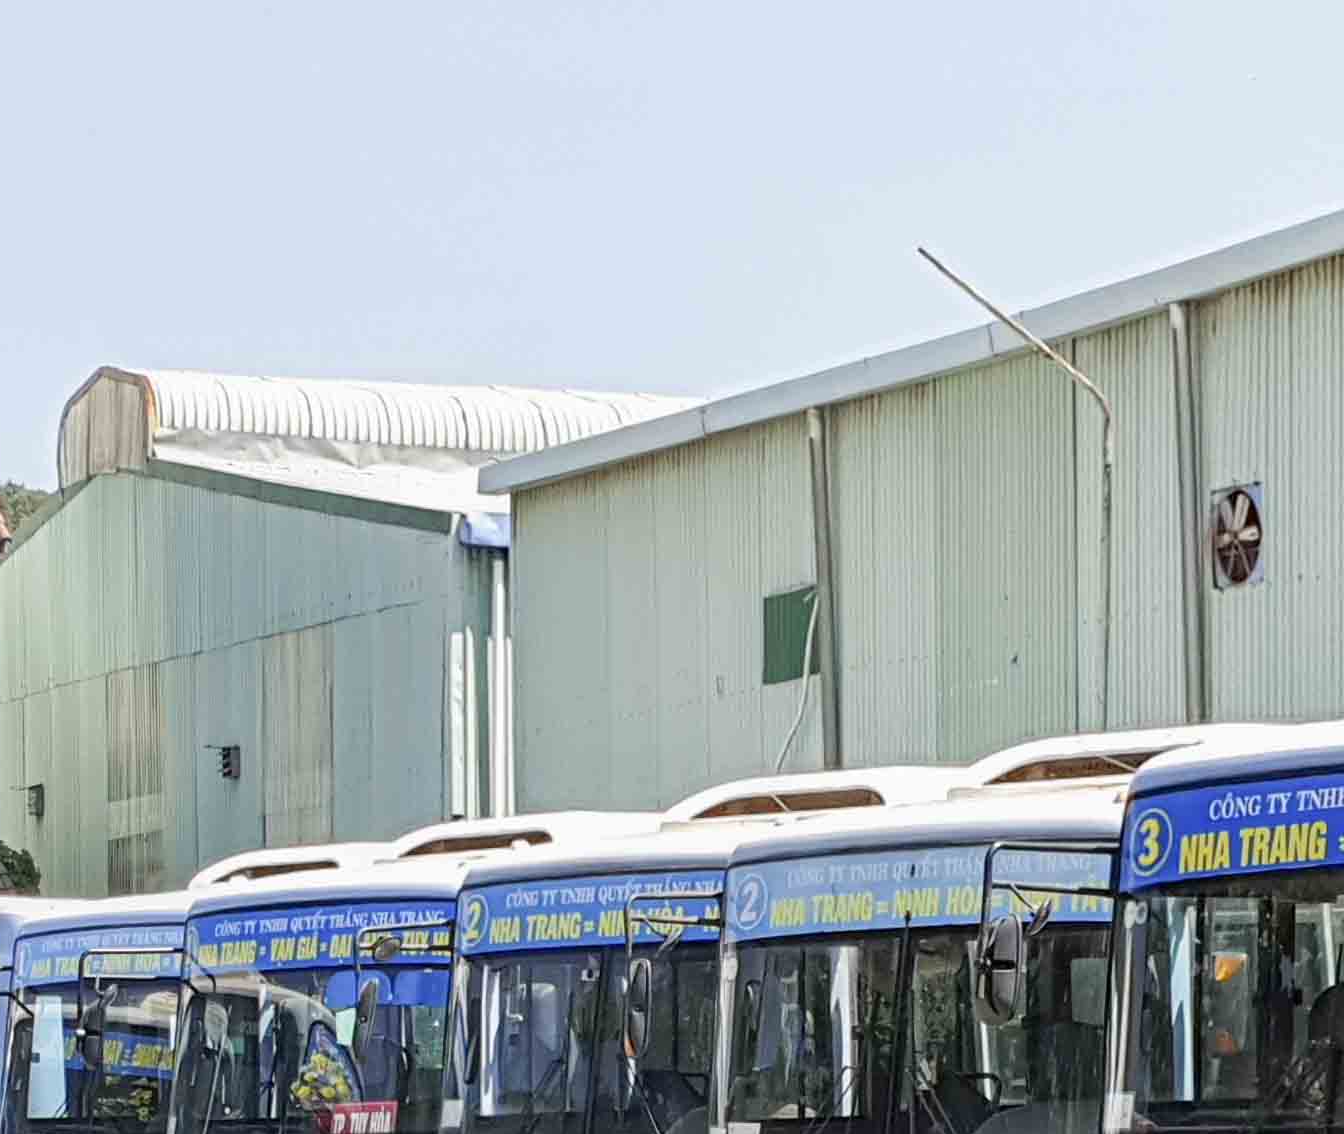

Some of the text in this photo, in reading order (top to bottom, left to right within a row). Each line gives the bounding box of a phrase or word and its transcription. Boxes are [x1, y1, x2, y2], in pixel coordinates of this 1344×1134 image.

[1209, 792, 1261, 820] CÔNG
[1267, 792, 1292, 814] TY
[1138, 819, 1160, 866] 3
[1178, 831, 1231, 874] NHA
[1239, 821, 1328, 867] TRANG
[740, 881, 757, 921] 2
[770, 898, 806, 928] NHA
[813, 891, 874, 924] TRANG
[215, 918, 241, 937] CÔNG
[244, 919, 258, 935] TY
[370, 911, 397, 929] NHA
[464, 901, 481, 940] 2
[489, 915, 520, 944] NHA
[527, 912, 580, 942] TRANG
[221, 939, 257, 966] TRANG
